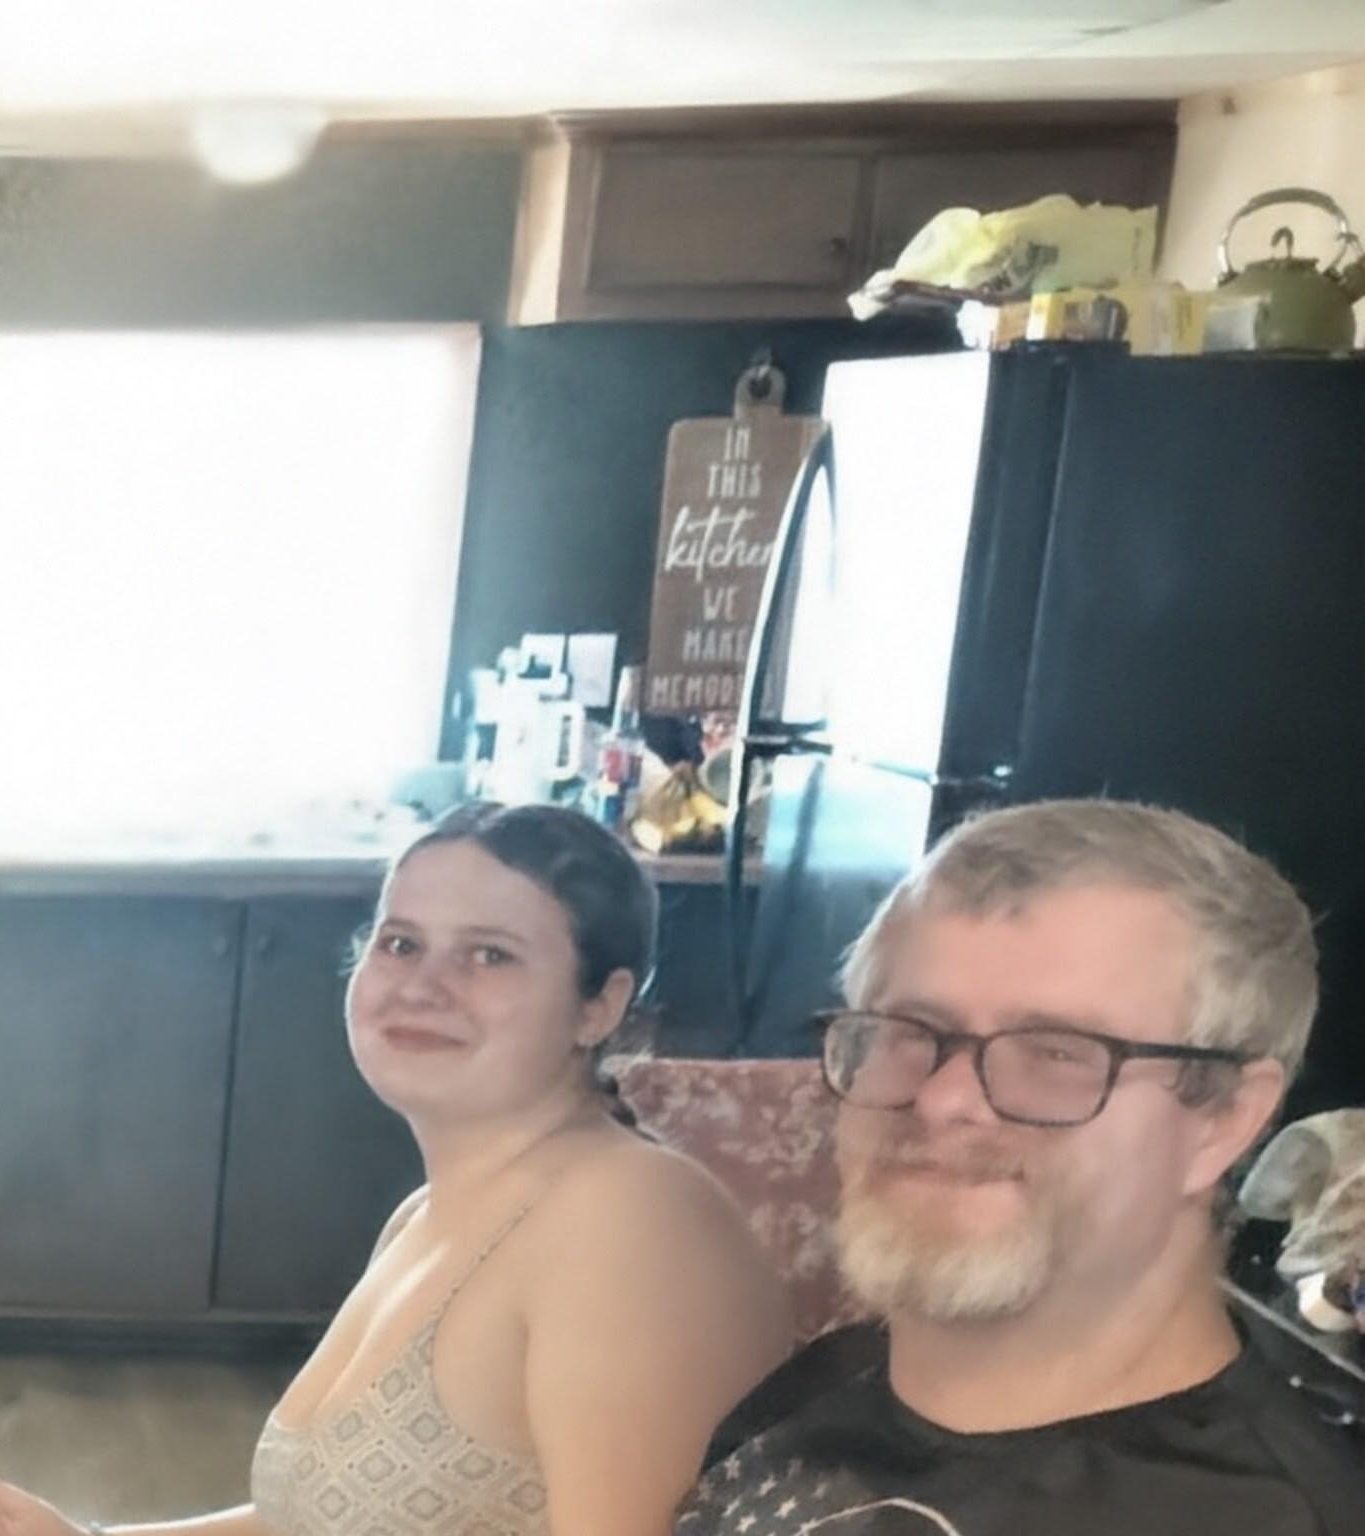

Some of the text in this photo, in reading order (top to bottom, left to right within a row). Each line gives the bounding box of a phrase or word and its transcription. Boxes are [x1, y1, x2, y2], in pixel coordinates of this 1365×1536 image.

[724, 427, 751, 461] IN
[707, 462, 761, 499] THIS
[703, 585, 739, 622] WE
[682, 627, 748, 665] MAKE
